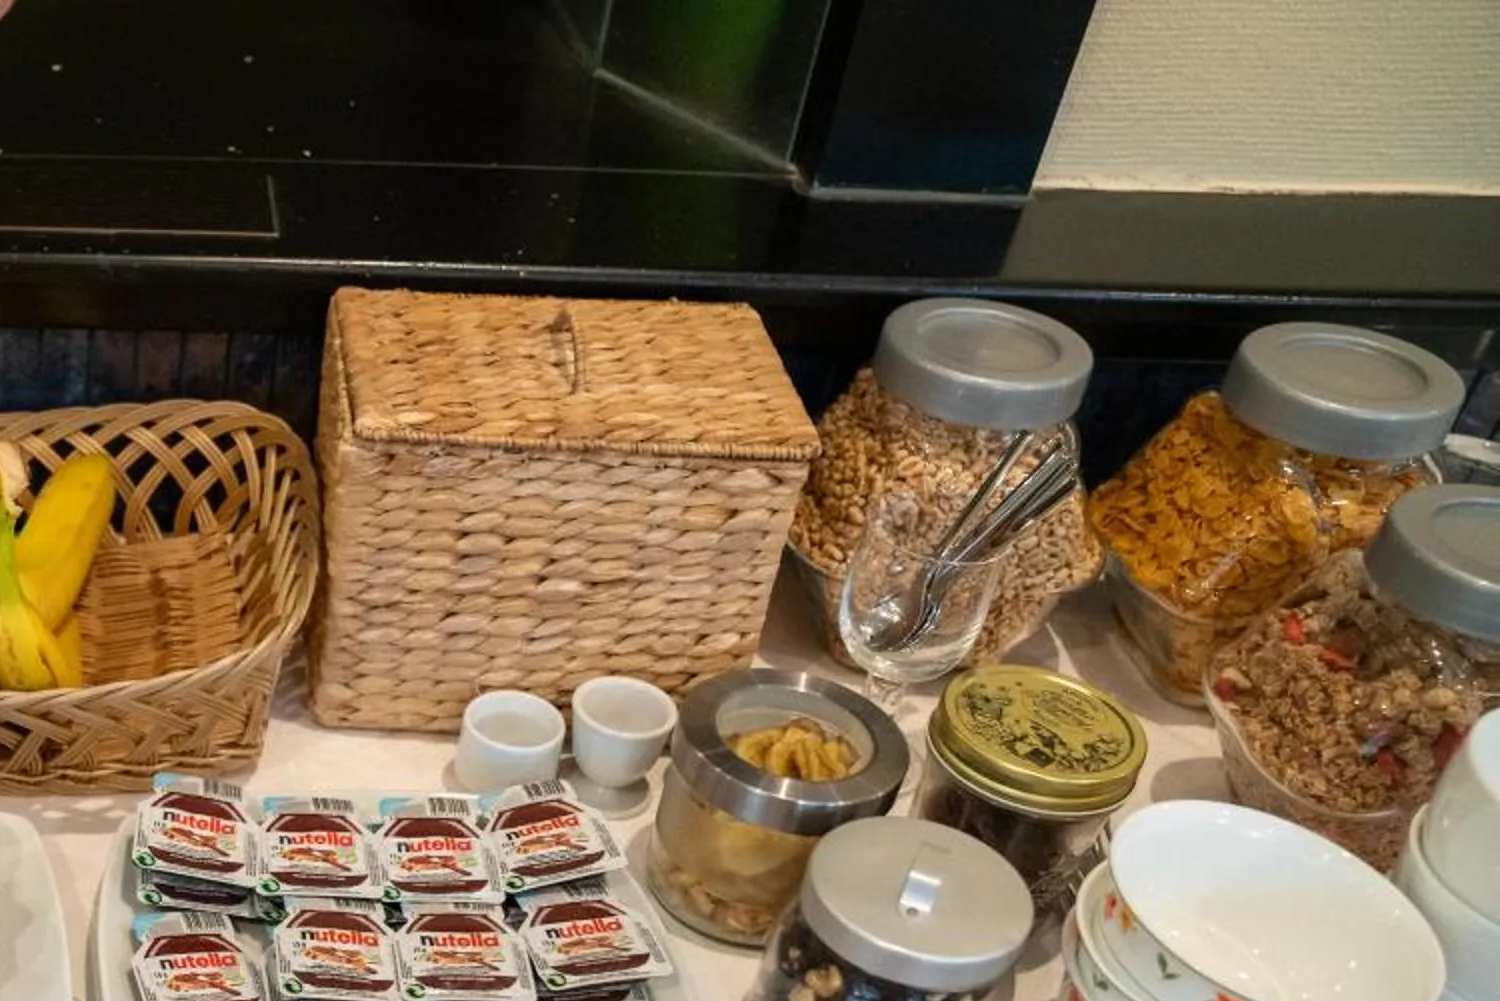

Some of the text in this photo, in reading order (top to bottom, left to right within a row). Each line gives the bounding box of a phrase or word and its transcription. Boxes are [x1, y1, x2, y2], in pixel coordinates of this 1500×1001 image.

[163, 809, 236, 835] nutella
[506, 815, 580, 840] nutella
[279, 832, 353, 847] nutella
[397, 839, 472, 853] nutella
[546, 918, 623, 939] nutella
[301, 929, 379, 947] nutella
[420, 933, 500, 948] nutella
[160, 953, 237, 970] nutella
